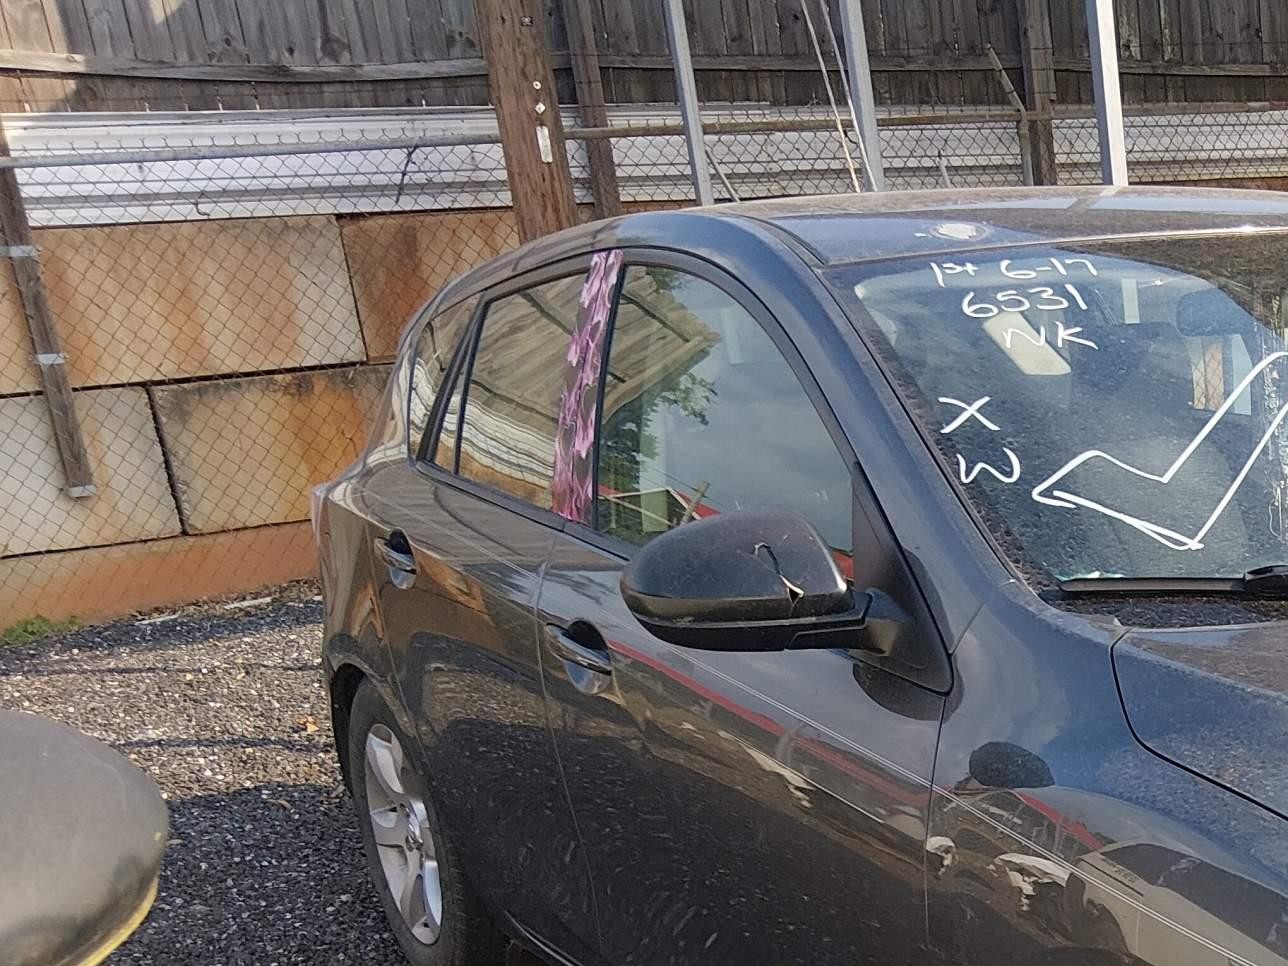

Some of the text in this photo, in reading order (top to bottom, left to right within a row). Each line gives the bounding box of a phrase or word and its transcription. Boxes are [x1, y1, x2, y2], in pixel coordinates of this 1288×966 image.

[1000, 258, 1098, 279] 6-17
[961, 284, 1088, 318] 6531
[1002, 321, 1099, 350] NK
